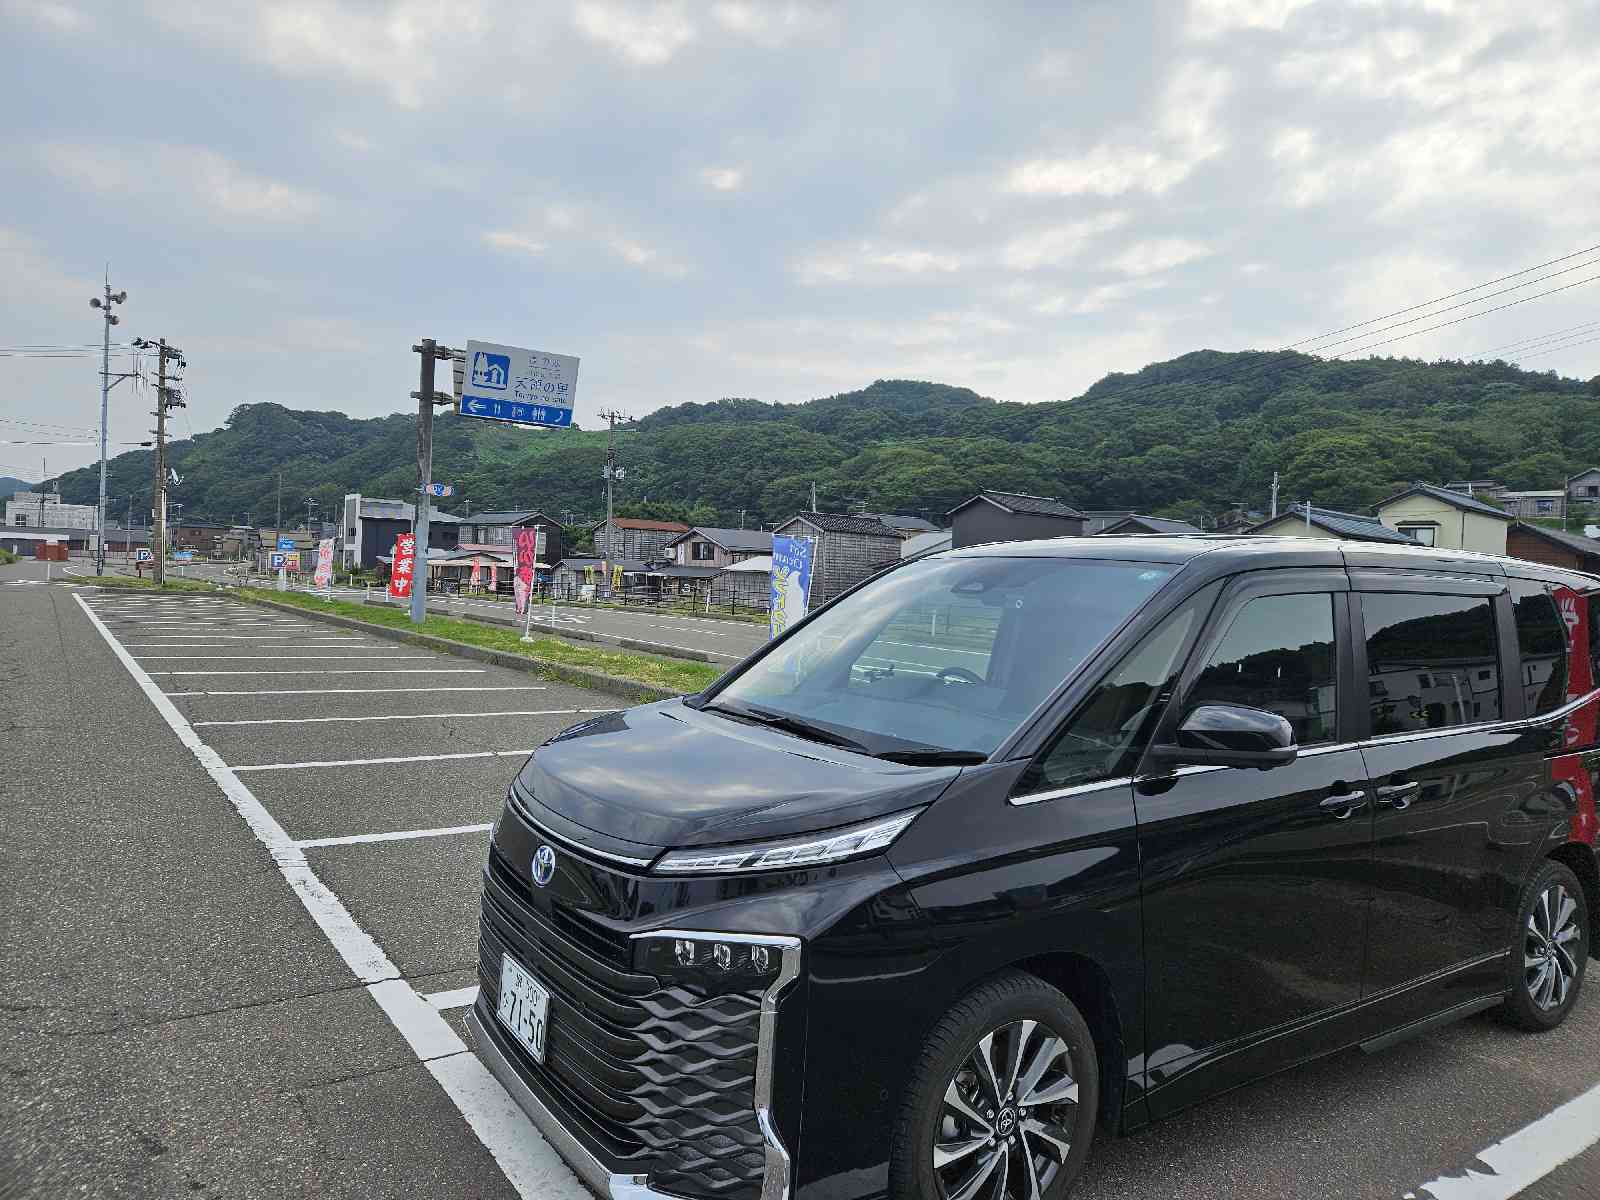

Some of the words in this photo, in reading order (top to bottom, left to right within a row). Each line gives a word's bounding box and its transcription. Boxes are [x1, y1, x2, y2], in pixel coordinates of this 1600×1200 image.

[395, 537, 414, 593] 営業中
[510, 990, 543, 1053] 71-50
